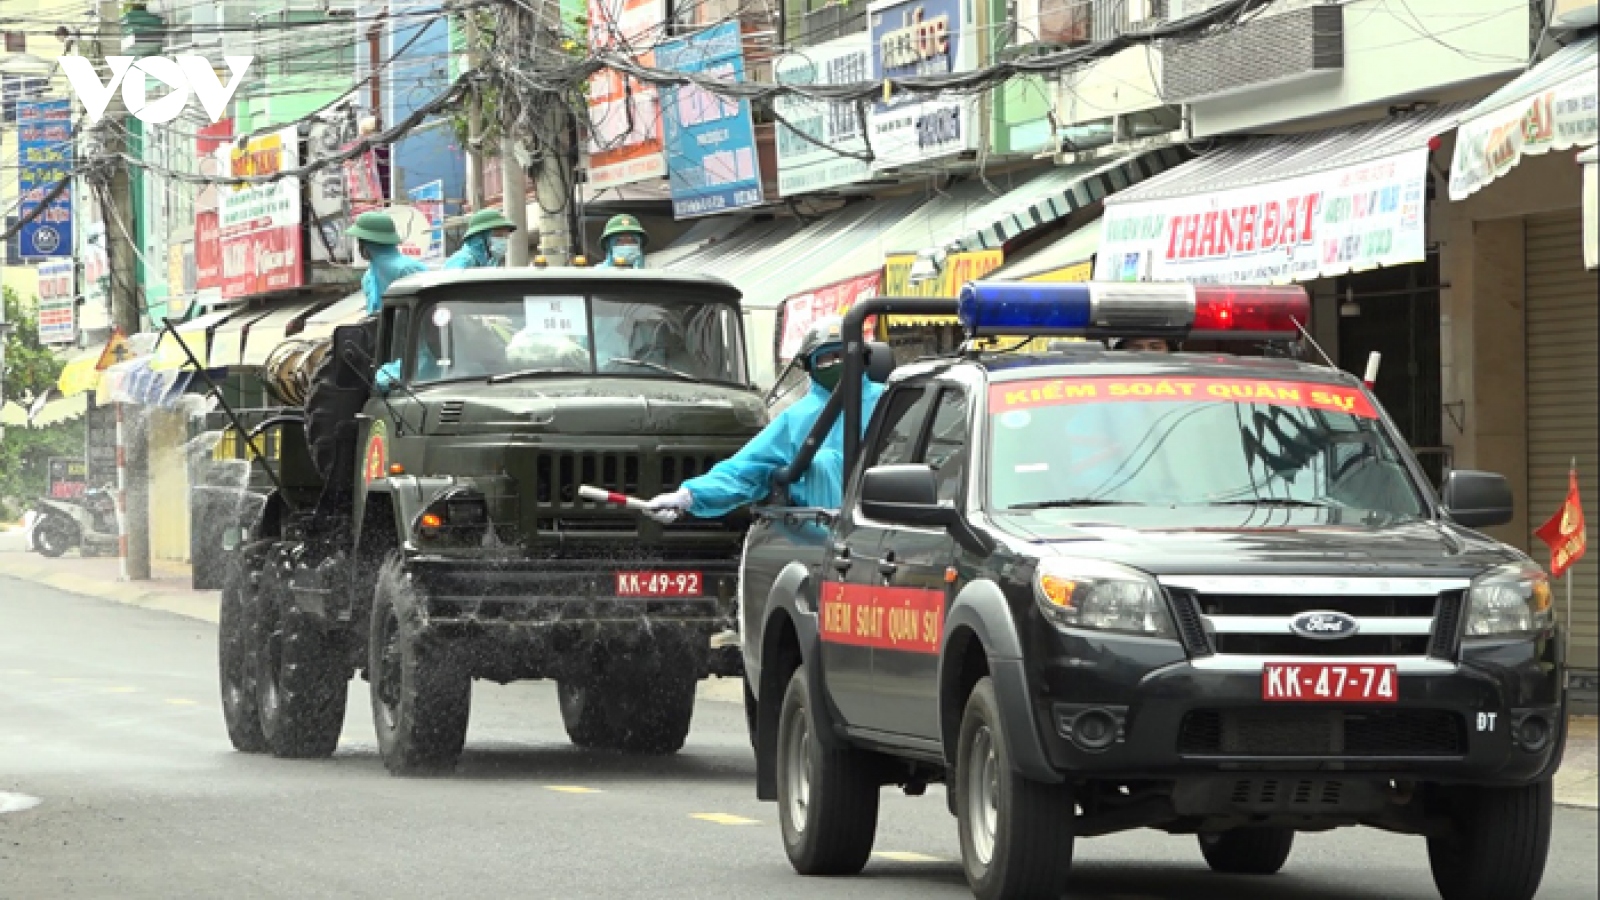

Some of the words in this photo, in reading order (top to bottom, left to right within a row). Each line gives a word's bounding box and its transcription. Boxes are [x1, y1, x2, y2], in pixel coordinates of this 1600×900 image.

[1166, 197, 1258, 260] THÀNH
[1261, 192, 1320, 257] ĐẠT
[1005, 380, 1096, 405] KIỂM
[1108, 380, 1197, 396] SOÁT
[1206, 383, 1299, 400] QUÂN
[1311, 391, 1355, 411] SỰ
[618, 573, 698, 594] KK-49-92
[856, 596, 884, 638] SOÁT
[888, 599, 919, 645] QUÂN
[923, 605, 940, 651] SỰ
[1306, 612, 1343, 632] Ford
[1266, 666, 1394, 698] KK-47-74
